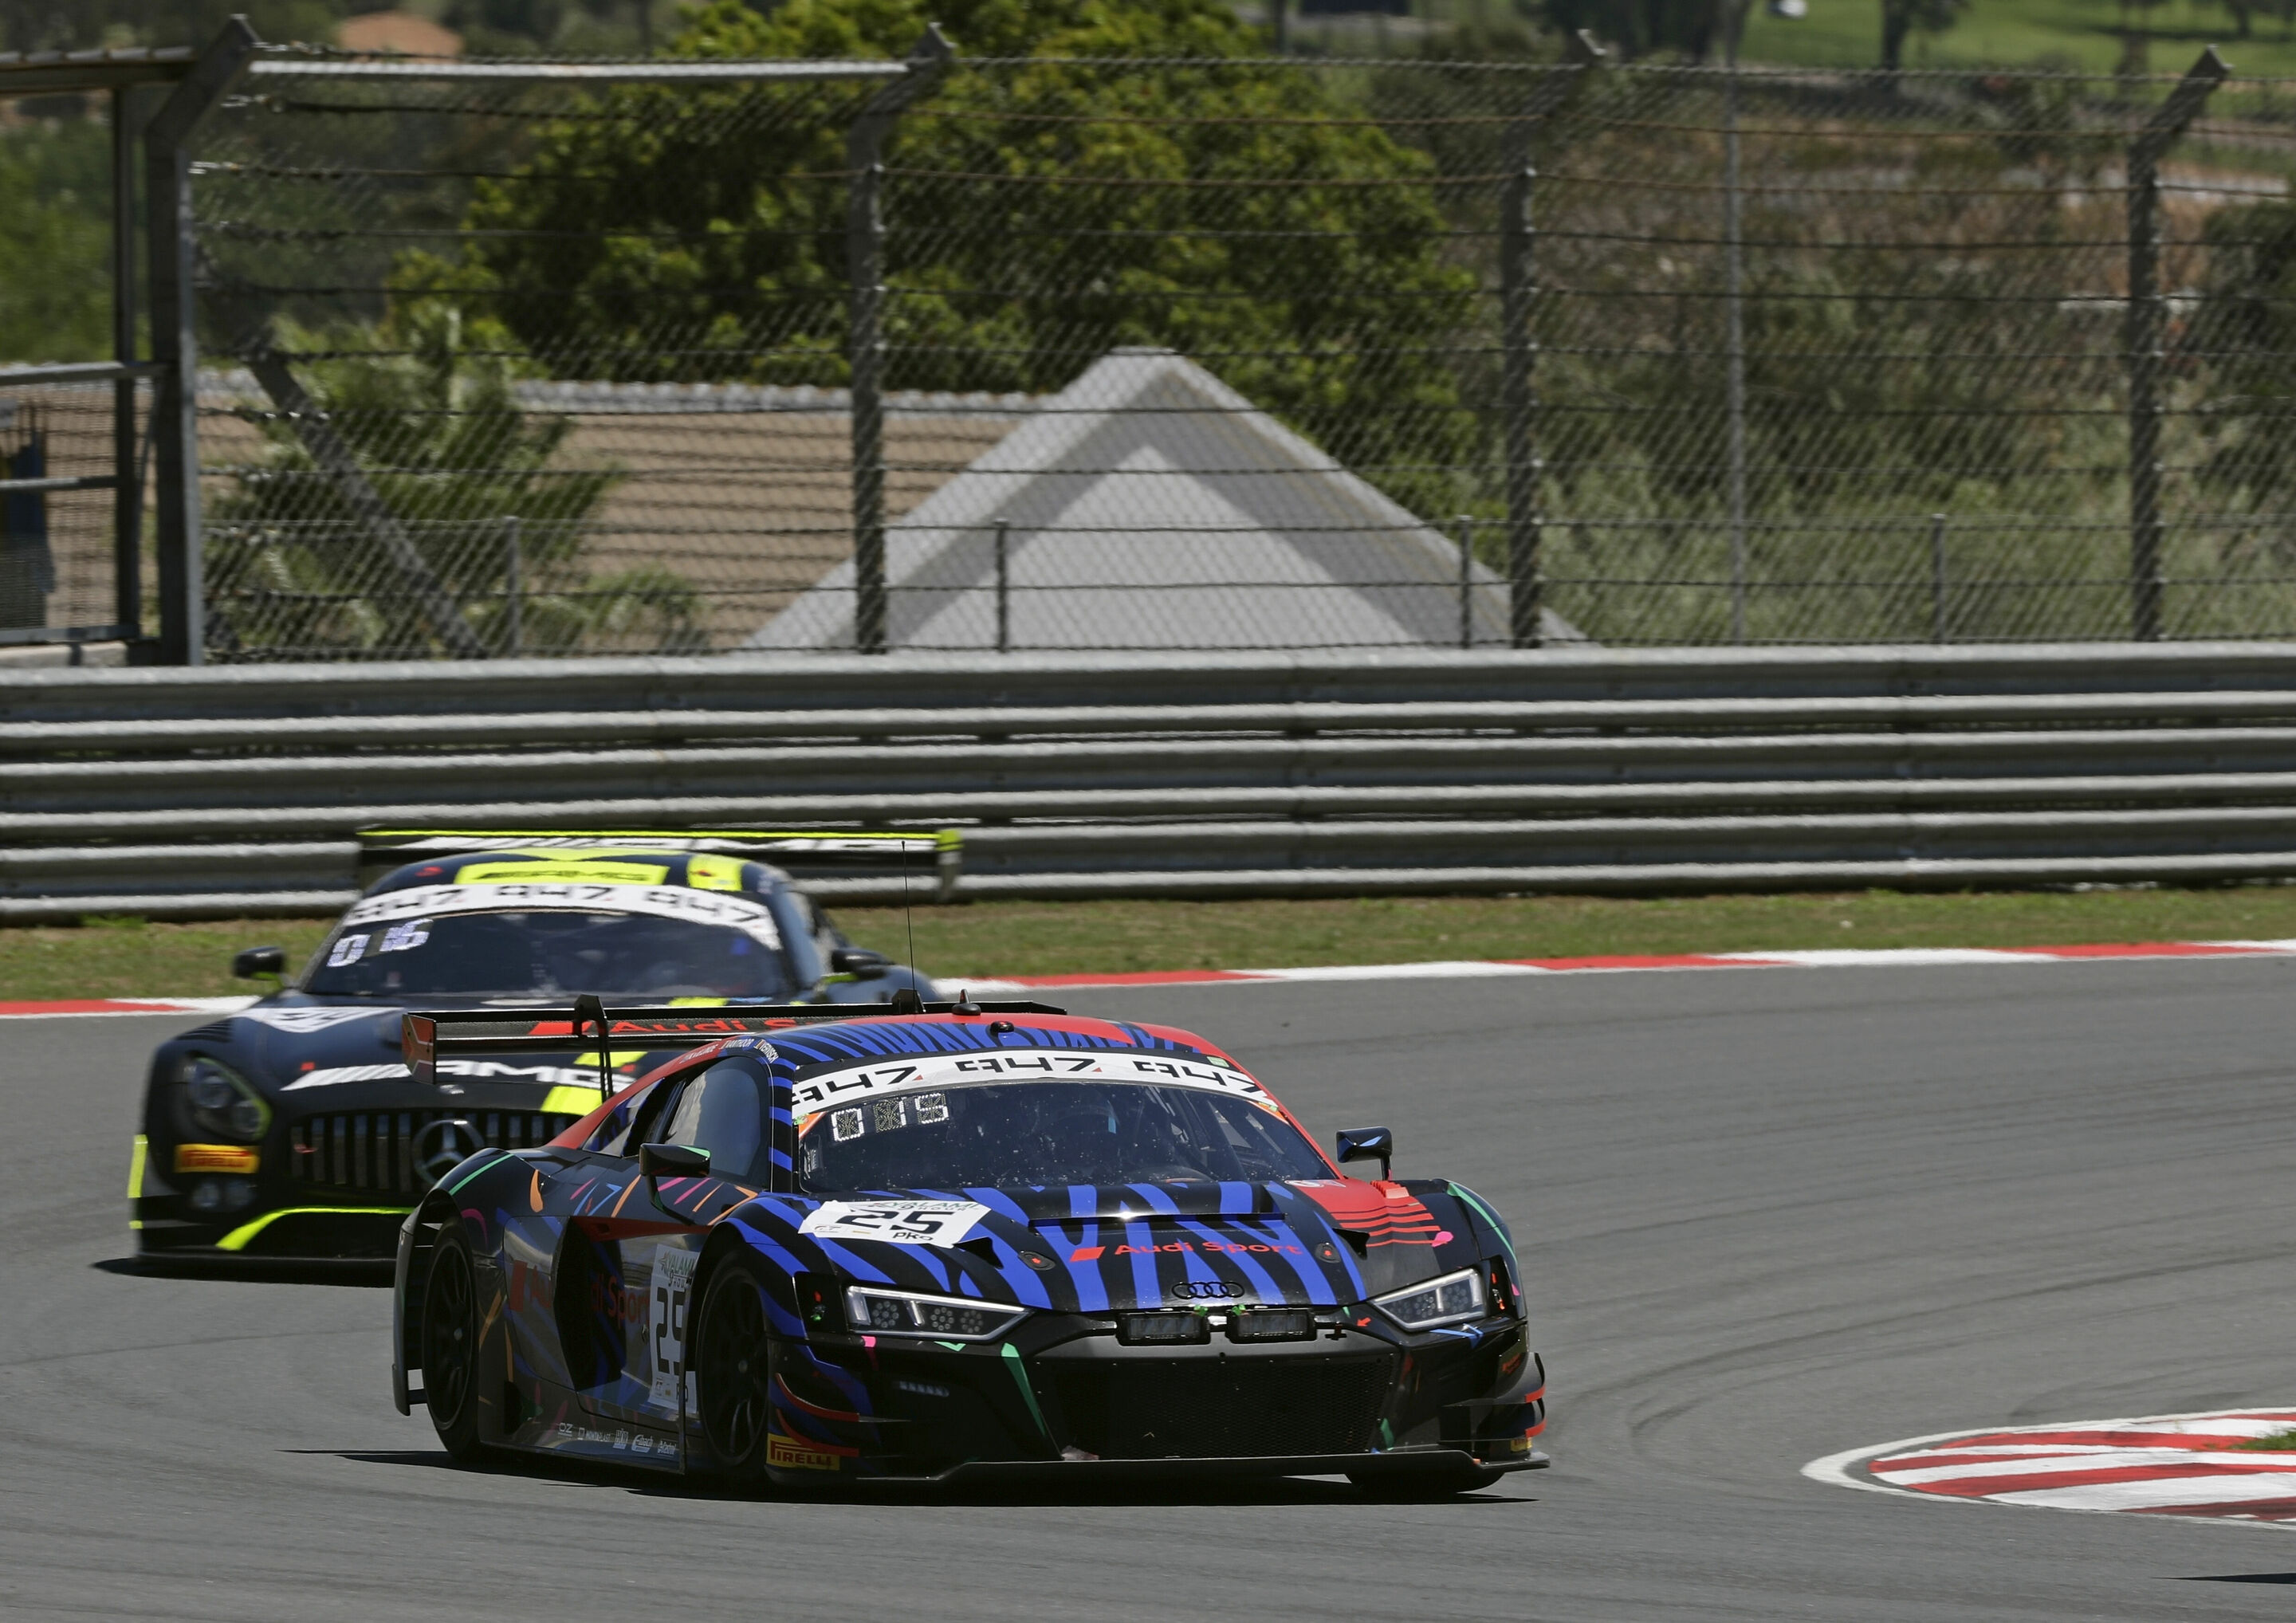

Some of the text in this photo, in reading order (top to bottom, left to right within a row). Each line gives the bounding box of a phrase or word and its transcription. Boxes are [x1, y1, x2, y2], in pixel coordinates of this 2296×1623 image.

[495, 885, 614, 900] 947
[609, 1020, 747, 1032] Audi
[435, 1060, 637, 1094] AMG
[792, 1056, 1260, 1105] 947 947 947
[835, 1208, 955, 1234] 25
[1114, 1241, 1303, 1256] Audi Sport
[559, 1422, 573, 1433] OZ
[770, 1440, 832, 1465] PIRELLI
